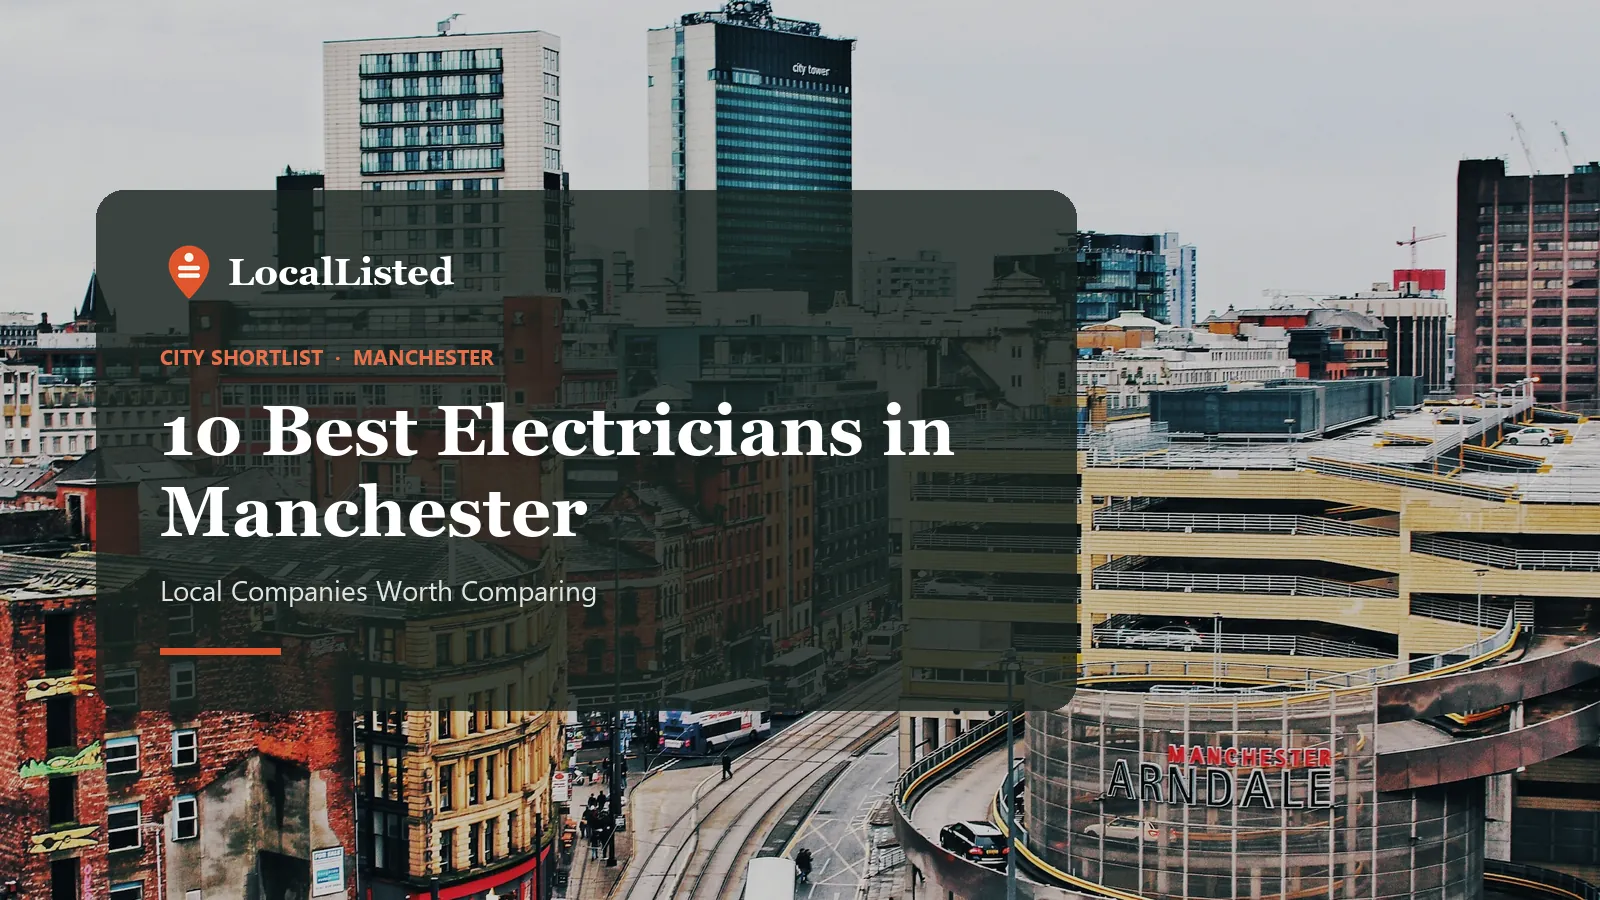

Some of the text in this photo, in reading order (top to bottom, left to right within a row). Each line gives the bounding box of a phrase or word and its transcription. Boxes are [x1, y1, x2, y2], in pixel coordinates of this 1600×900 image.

[792, 62, 831, 76] city tower
[1167, 744, 1332, 768] MANCHESTER
[1107, 758, 1334, 810] ARNDALE
